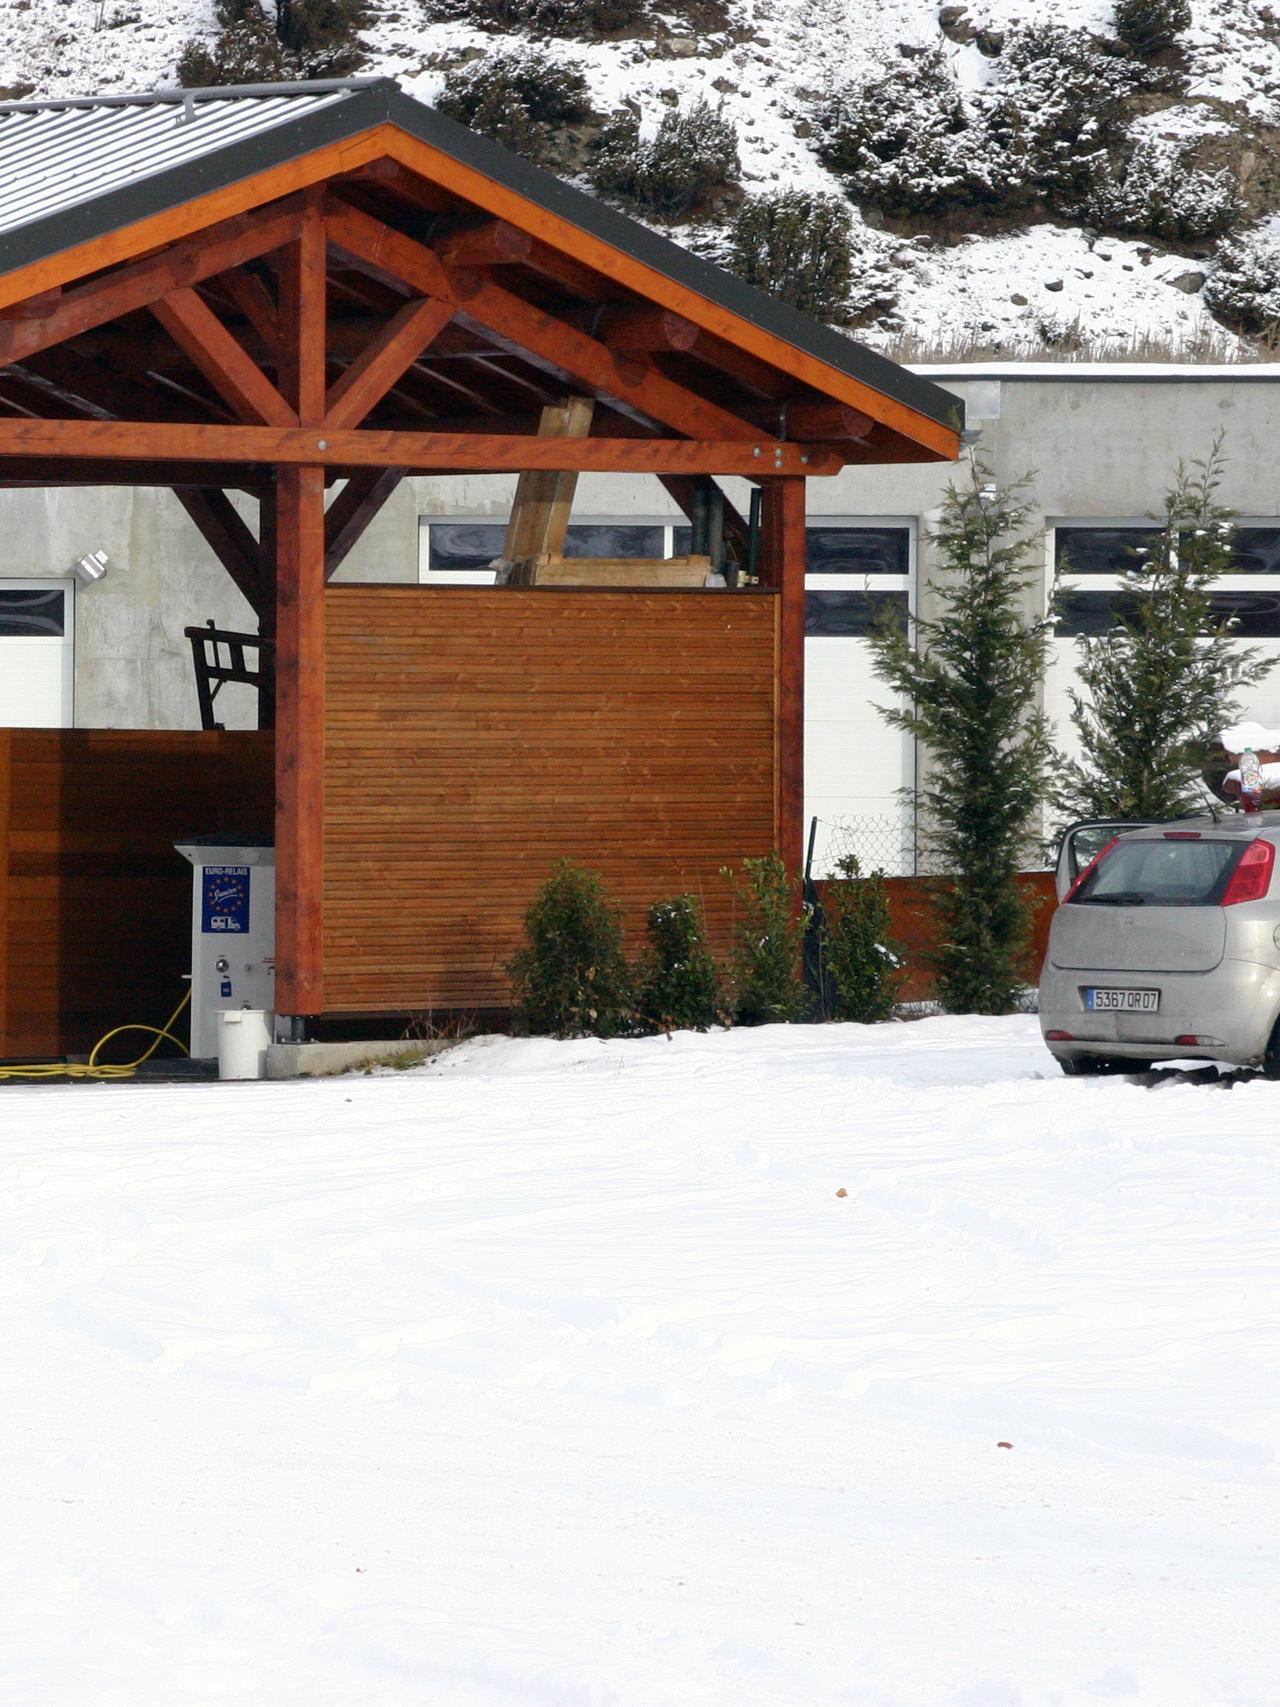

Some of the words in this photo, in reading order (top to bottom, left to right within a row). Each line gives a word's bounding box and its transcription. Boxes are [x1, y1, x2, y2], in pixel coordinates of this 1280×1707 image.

[205, 867, 248, 875] EURO-RELAIS
[1096, 992, 1126, 1008] 5367
[1143, 993, 1157, 1008] 07
